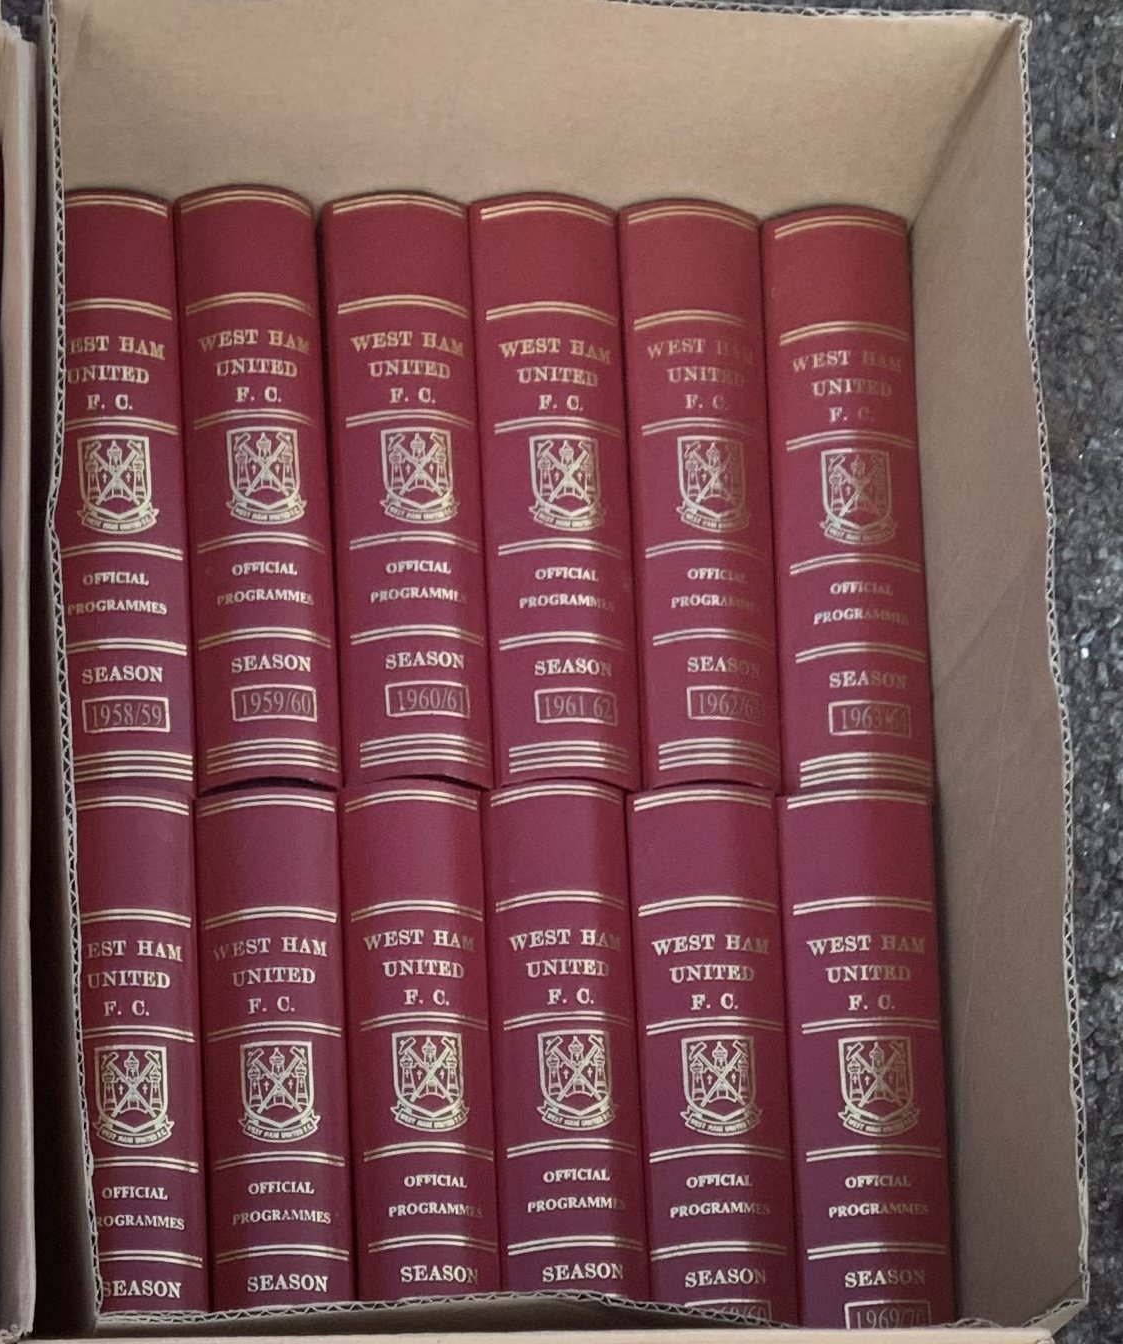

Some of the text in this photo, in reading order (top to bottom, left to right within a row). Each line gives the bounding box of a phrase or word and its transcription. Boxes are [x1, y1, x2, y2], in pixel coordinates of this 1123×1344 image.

[350, 331, 463, 356] WEST HAM
[68, 365, 149, 384] UNITED
[217, 358, 297, 377] UNITED
[368, 360, 450, 379] UNITED
[517, 366, 597, 386] UNITED
[232, 654, 311, 673] SEASON
[386, 651, 464, 669] SEASON
[535, 658, 611, 675] SEASON
[83, 665, 163, 683] SEASON
[242, 691, 311, 715] 1959/60
[93, 703, 161, 727] 1958/59
[214, 937, 327, 959] WEST HAM
[651, 934, 767, 955] WEST HAM
[233, 967, 315, 986] UNITED
[382, 959, 464, 978] UNITED
[526, 959, 605, 977] UNITED
[669, 964, 753, 983] UNITED
[404, 1174, 467, 1188] OFFICIAL
[400, 1265, 478, 1282] SEASON
[542, 1263, 623, 1282] SEASON
[685, 1268, 761, 1287] SEASON
[103, 1280, 181, 1298] SEASON
[248, 1274, 328, 1292] SEASON
